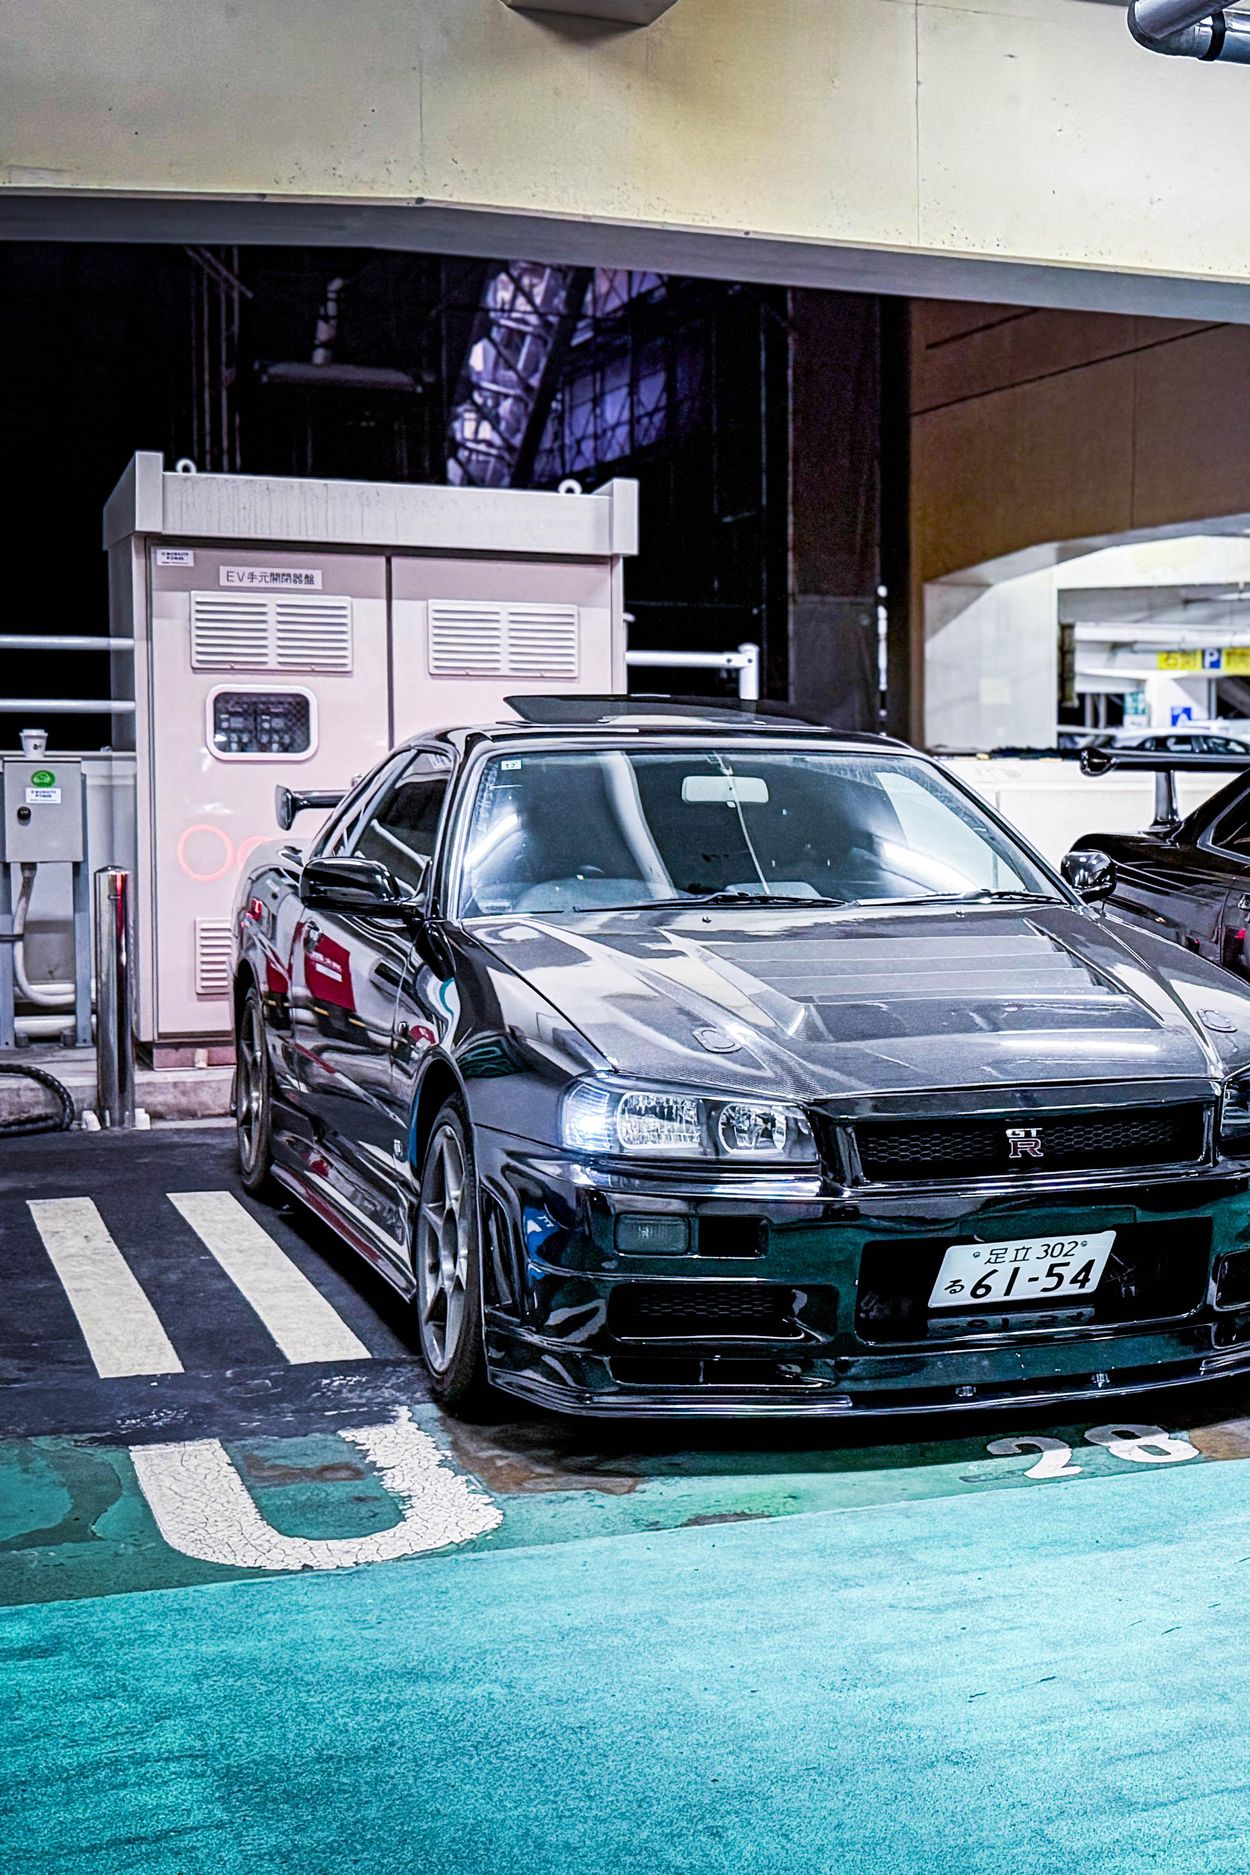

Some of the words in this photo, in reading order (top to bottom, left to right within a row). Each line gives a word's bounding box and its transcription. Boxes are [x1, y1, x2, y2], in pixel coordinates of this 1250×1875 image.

[1009, 1138, 1044, 1158] R
[984, 1246, 1032, 1265] 足立
[1036, 1240, 1079, 1260] 302
[944, 1279, 965, 1294] る
[970, 1258, 1096, 1299] 61-54
[986, 1423, 1200, 1479] 28
